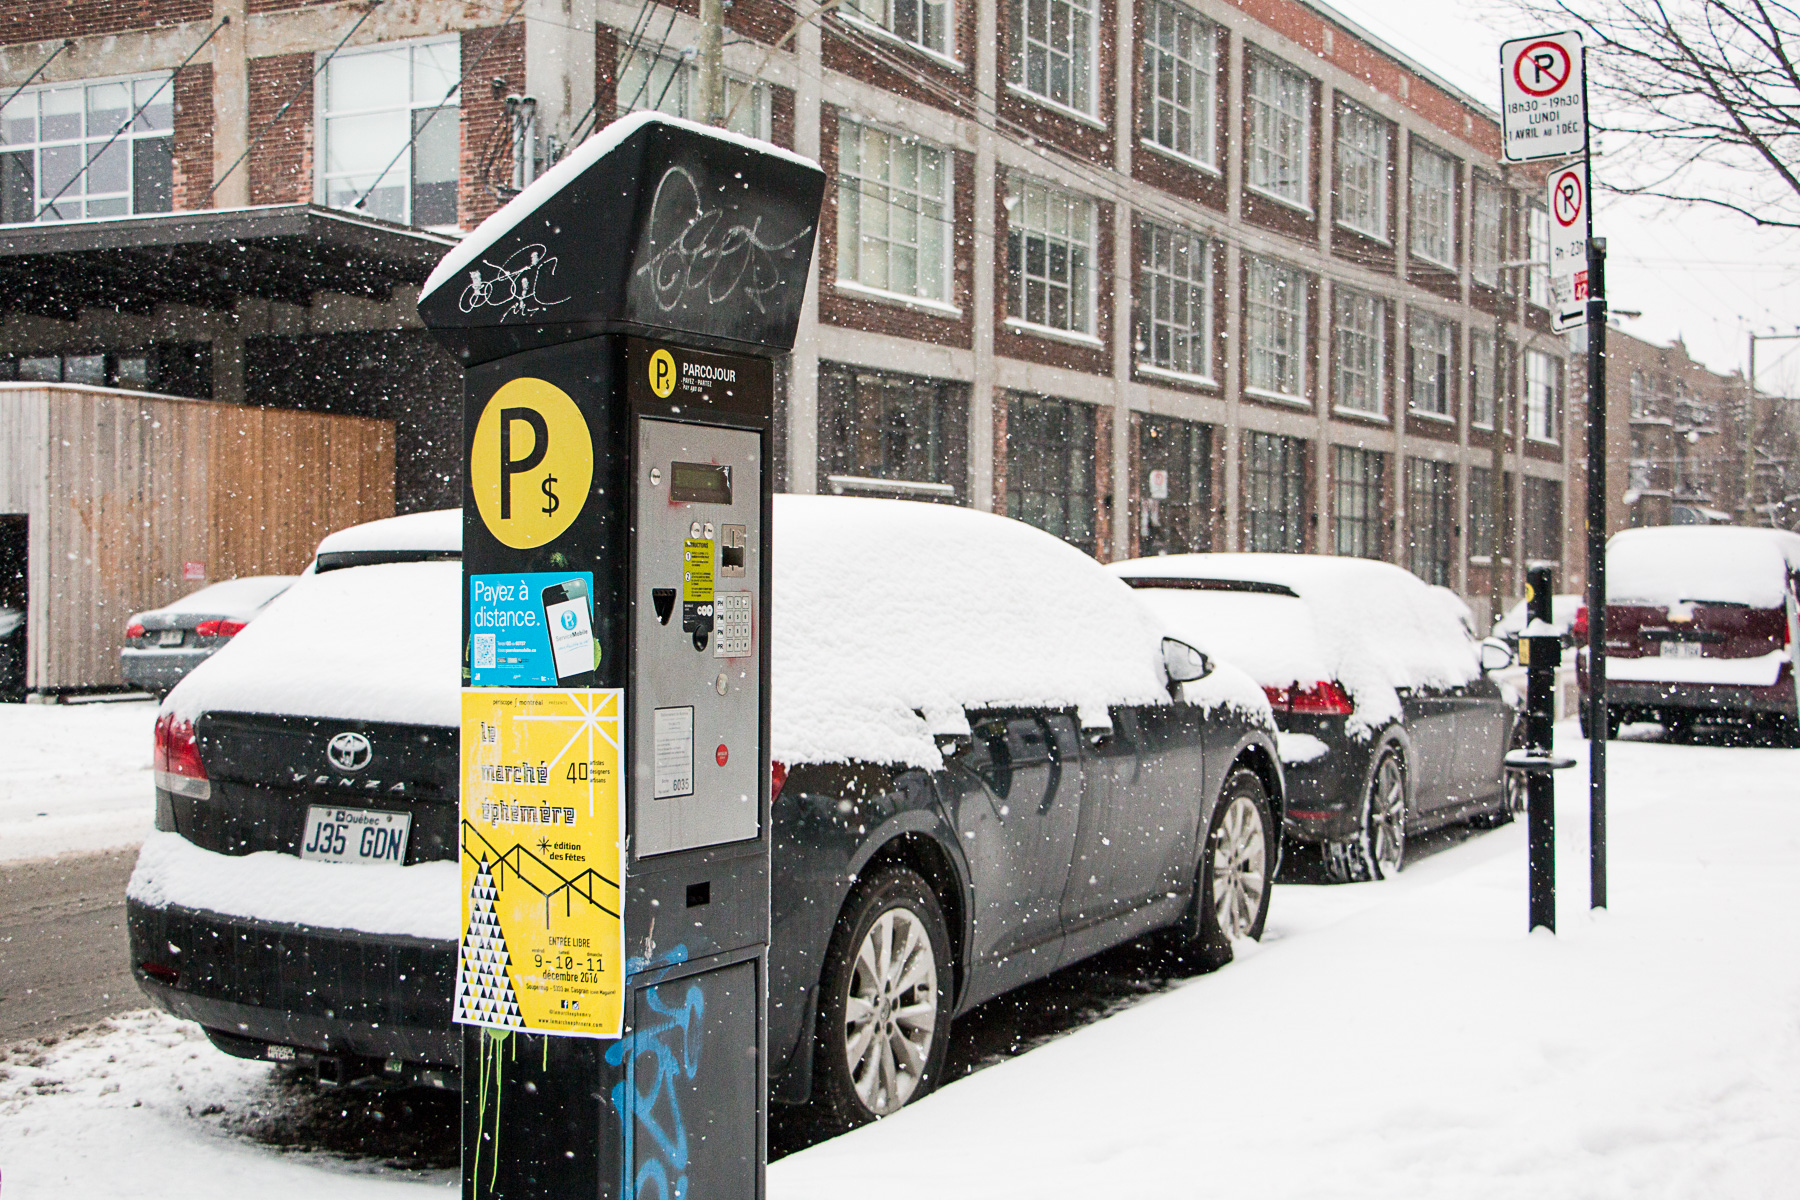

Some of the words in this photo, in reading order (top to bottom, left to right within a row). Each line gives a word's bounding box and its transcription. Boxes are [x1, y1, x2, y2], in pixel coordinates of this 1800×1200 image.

[1508, 100, 1538, 114] 18h30
[1549, 94, 1579, 109] 19h30
[1529, 111, 1560, 124] LUNDI
[1509, 130, 1513, 141] 1
[1516, 127, 1539, 139] AVRIL
[1556, 124, 1560, 135] 1
[1570, 240, 1584, 257] 23h
[682, 362, 736, 382] PARCOJOUR
[682, 377, 695, 385] PAYEZ
[697, 379, 712, 388] PARTEZ
[474, 580, 515, 606] Payez
[518, 579, 529, 601] à
[474, 605, 541, 628] distance.
[481, 760, 549, 786] marché
[566, 762, 588, 784] 40
[292, 773, 405, 791] VENZA
[673, 778, 689, 791] 6035
[346, 814, 380, 825] Québec
[481, 797, 577, 827] éphémère
[306, 822, 349, 854] J35
[360, 827, 403, 860] GDN
[554, 841, 581, 850] édition
[550, 852, 563, 860] des
[565, 852, 586, 862] Fêtes
[548, 935, 571, 946] ENTRÉE
[572, 938, 591, 948] LIBRE
[542, 970, 578, 983] décembre
[580, 972, 598, 984] 2016
